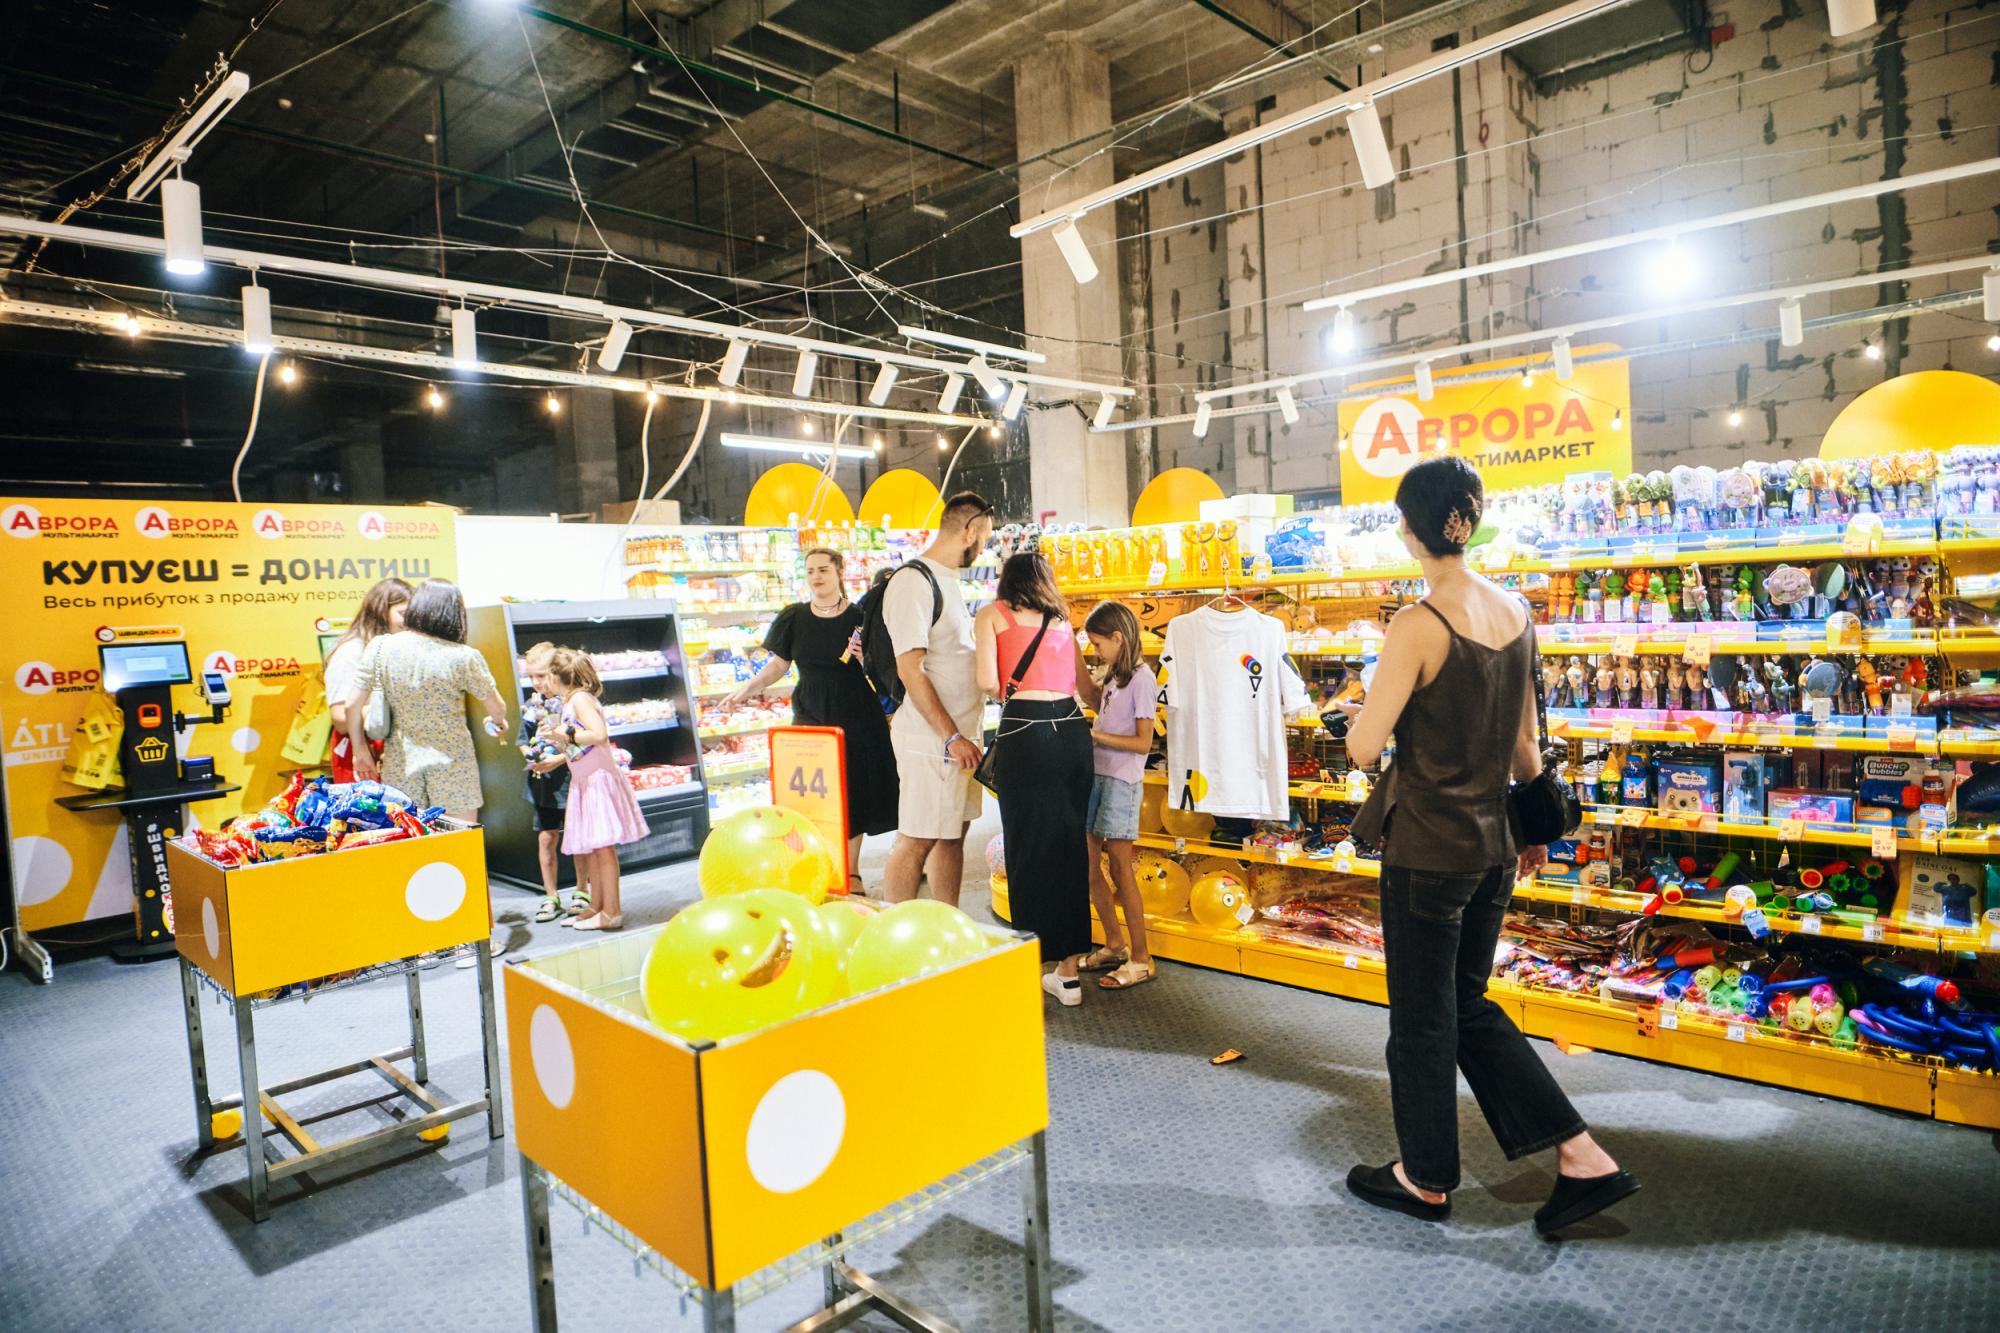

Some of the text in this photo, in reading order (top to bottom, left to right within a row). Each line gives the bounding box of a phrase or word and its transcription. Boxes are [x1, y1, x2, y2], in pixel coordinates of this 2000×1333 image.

[1366, 398, 1595, 460] АВРОРА
[1458, 441, 1595, 468] ЬТИМАРКЕТ
[10, 510, 119, 531] АВРОРА
[143, 513, 239, 532] АВРОРА
[260, 514, 345, 533] АВРОРА
[364, 516, 440, 534] АВРОРА
[43, 559, 219, 585] КУПУЄШ
[259, 558, 430, 585] ДОНАТИШ
[44, 595, 96, 609] Весь
[103, 592, 199, 609] прибуток
[205, 593, 215, 604] з
[220, 589, 300, 604] продажу
[213, 656, 301, 673] АВРОРА
[25, 667, 100, 687] АВРО
[789, 766, 828, 799] 44
